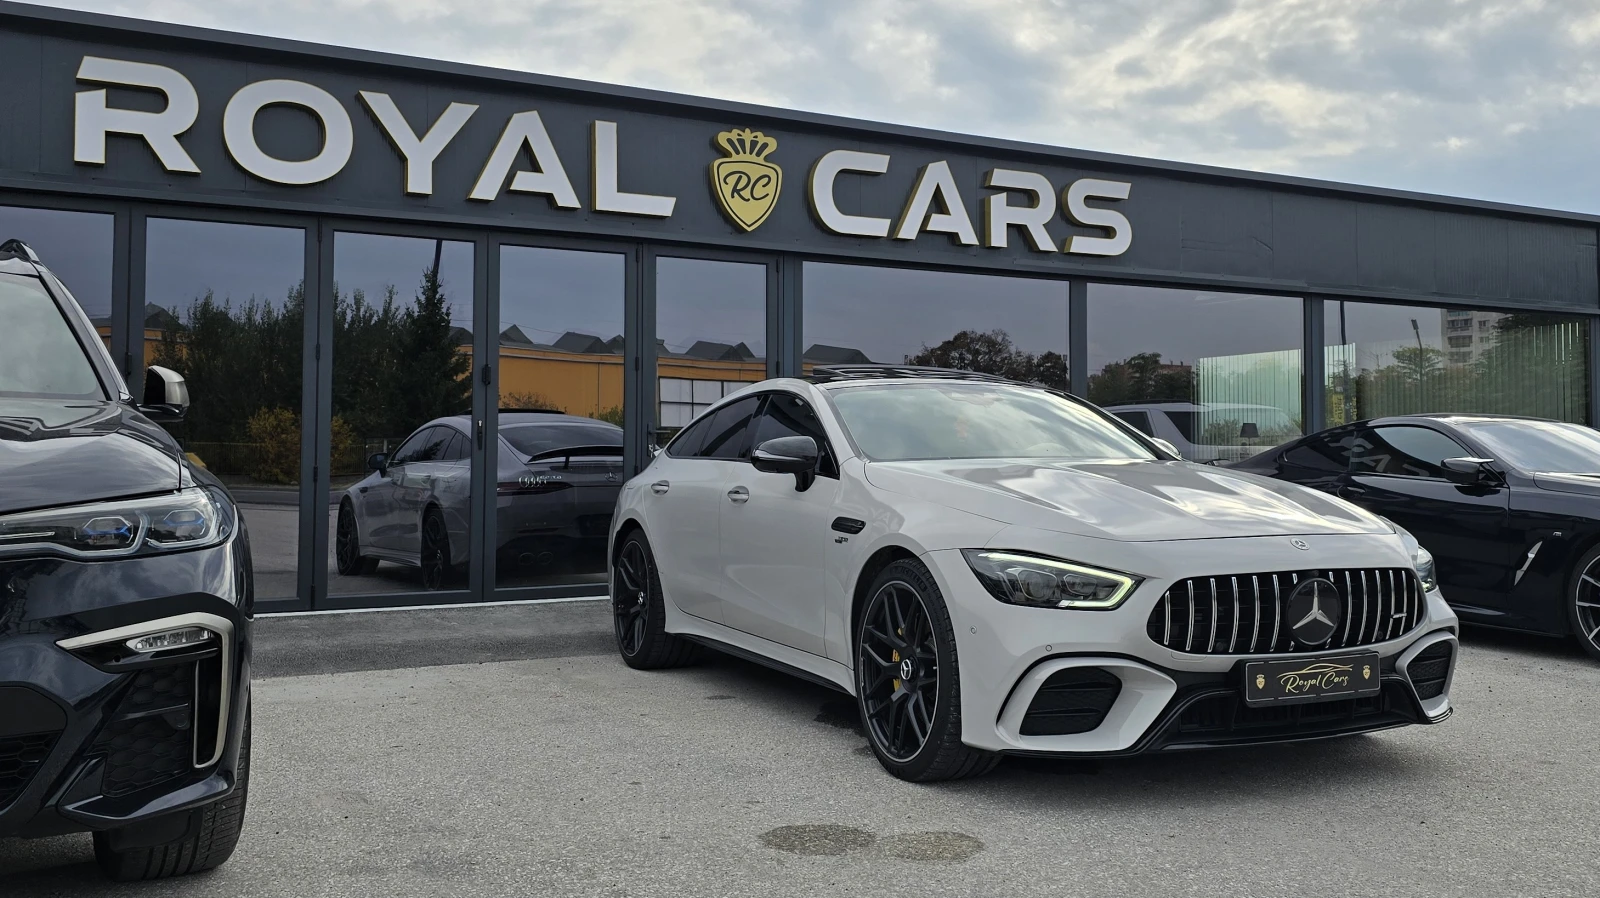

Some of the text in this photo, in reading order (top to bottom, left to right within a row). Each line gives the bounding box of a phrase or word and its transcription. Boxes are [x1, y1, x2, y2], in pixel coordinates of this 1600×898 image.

[74, 56, 1133, 257] ROYAL CARS
[723, 170, 772, 202] RC
[1280, 671, 1349, 693] Royal Cars
